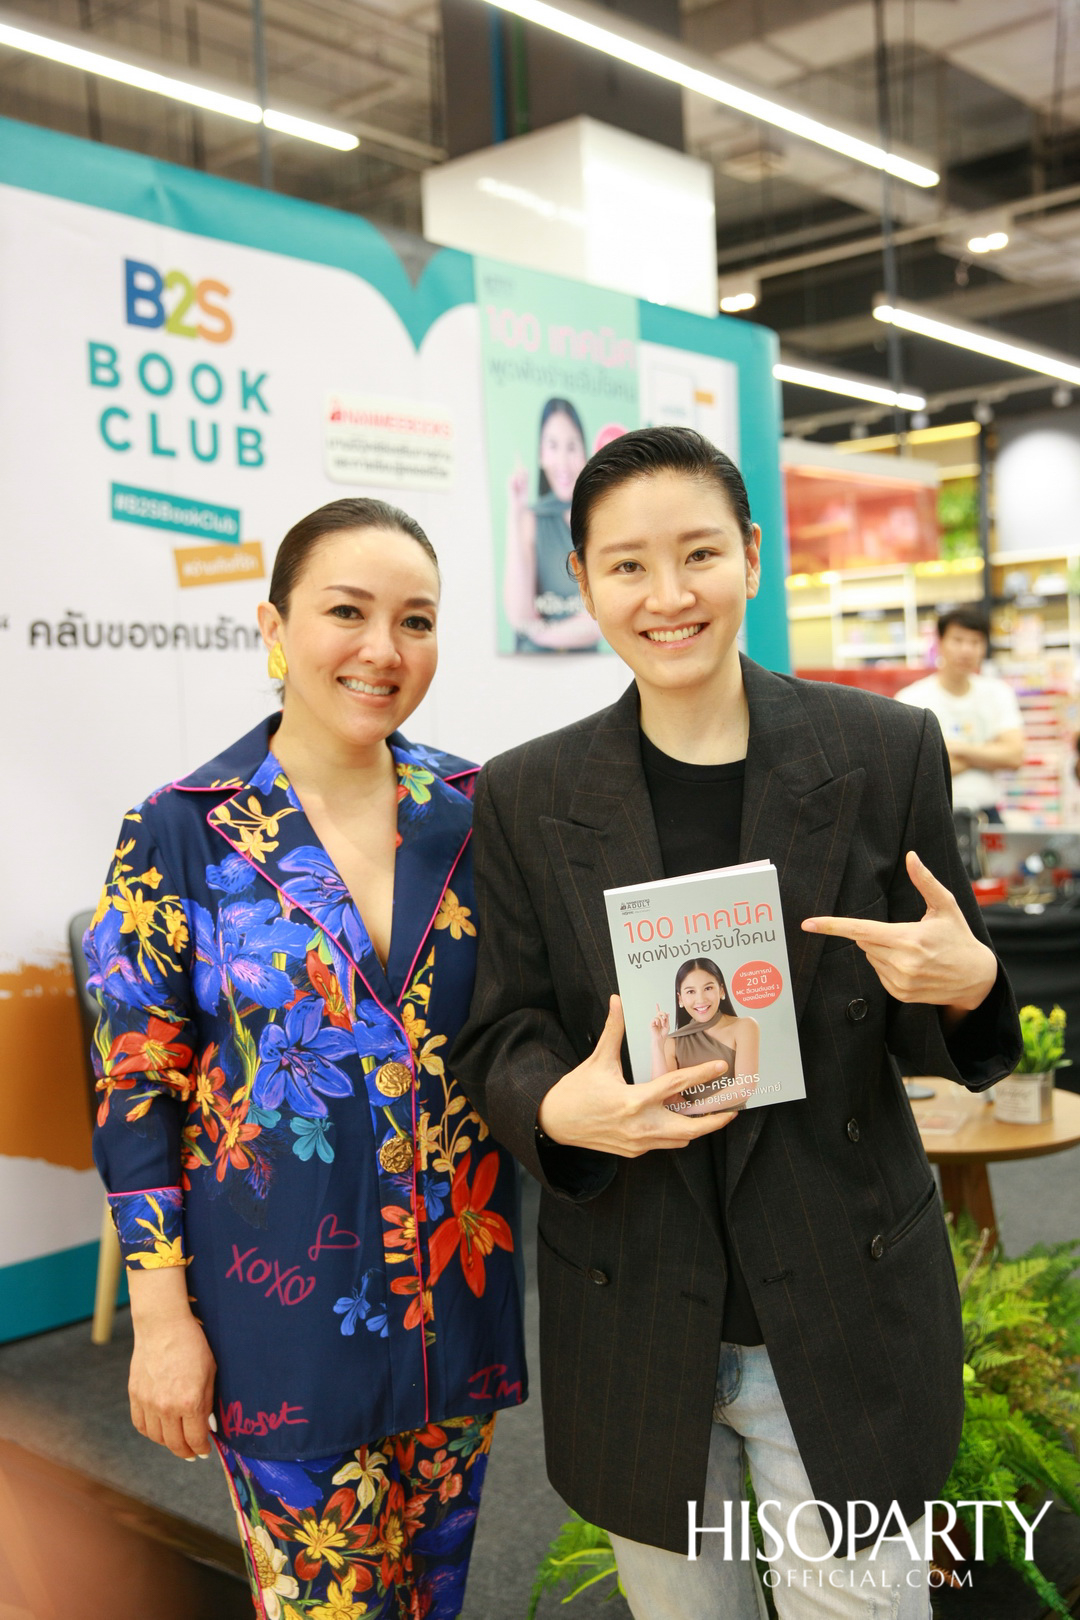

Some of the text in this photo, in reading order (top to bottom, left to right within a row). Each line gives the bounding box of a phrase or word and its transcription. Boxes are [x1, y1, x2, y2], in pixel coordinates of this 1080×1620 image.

[125, 258, 234, 344] B2S
[487, 305, 541, 352] 100
[87, 340, 270, 414] BOOK
[99, 406, 266, 468] CLUB
[623, 901, 773, 943] 100 เทคนิค
[627, 928, 776, 969] พูดฟังง่ายจับใจคน
[747, 974, 767, 986] 20 ปี
